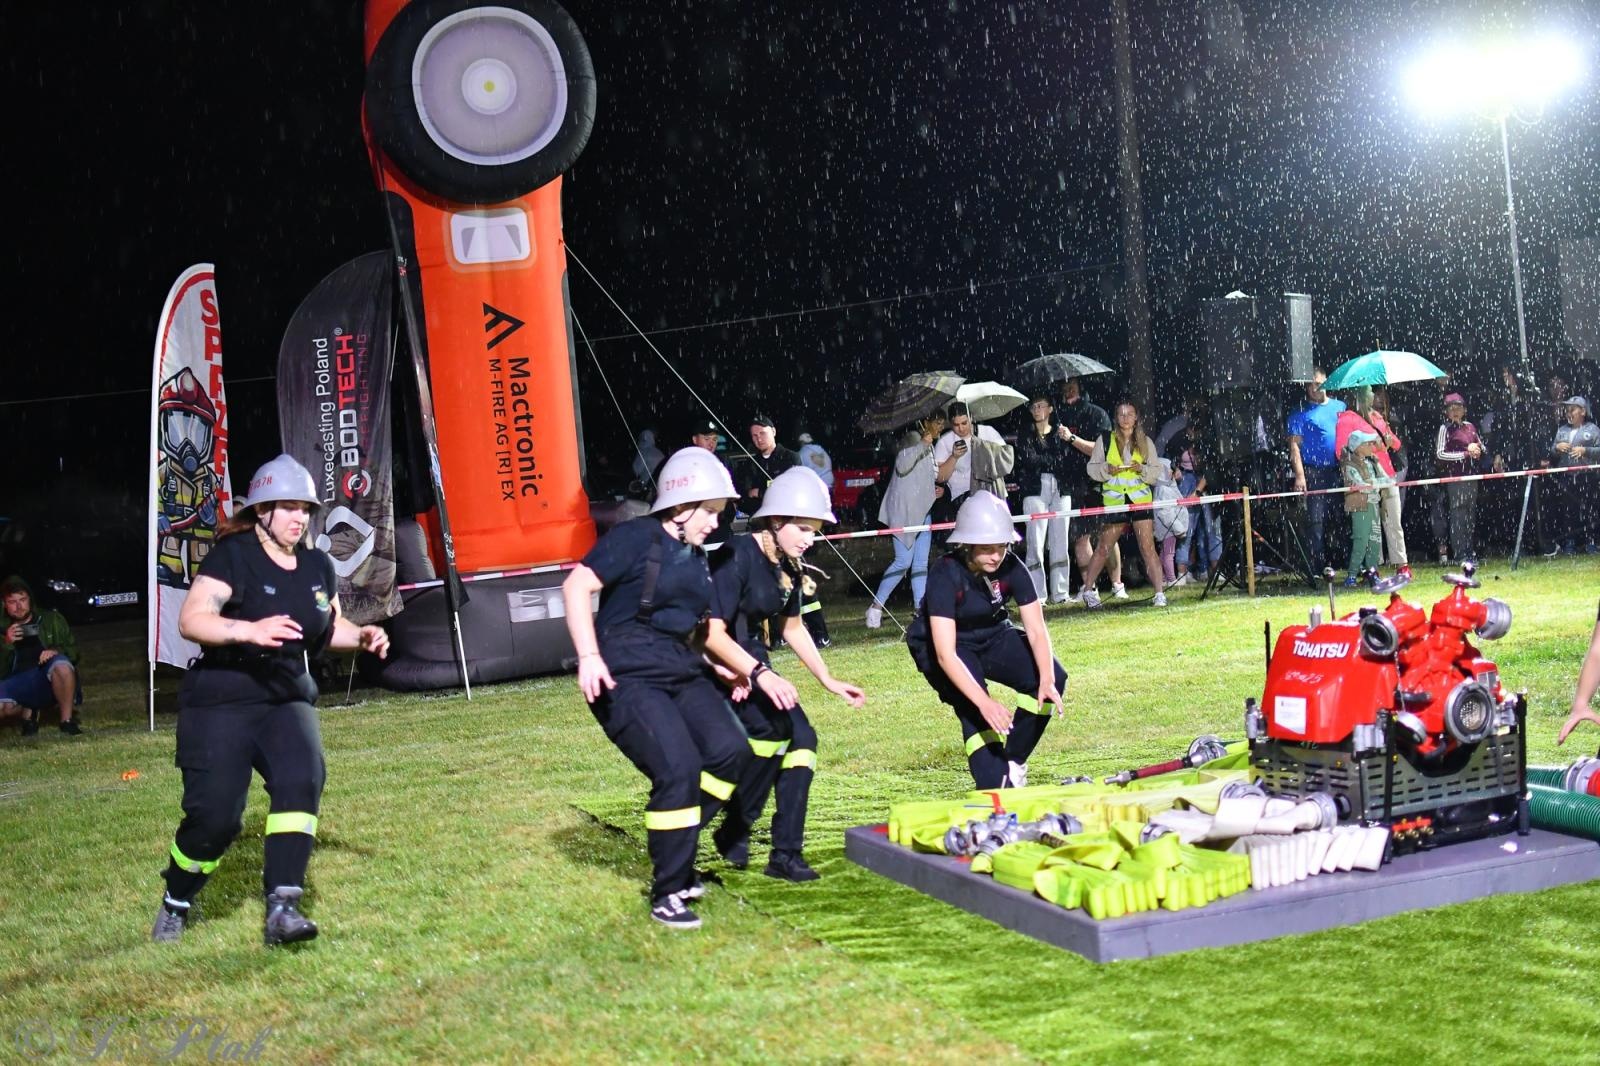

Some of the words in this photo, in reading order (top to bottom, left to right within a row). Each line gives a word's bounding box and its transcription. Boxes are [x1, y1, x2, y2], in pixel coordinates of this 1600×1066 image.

[312, 337, 331, 396] Poland
[489, 358, 506, 418] M-FIRE
[318, 401, 336, 503] Luxecasting
[495, 422, 509, 446] AG
[508, 357, 543, 496] Mactronic
[501, 480, 515, 501] EX
[1293, 640, 1350, 658] TOHATSU
